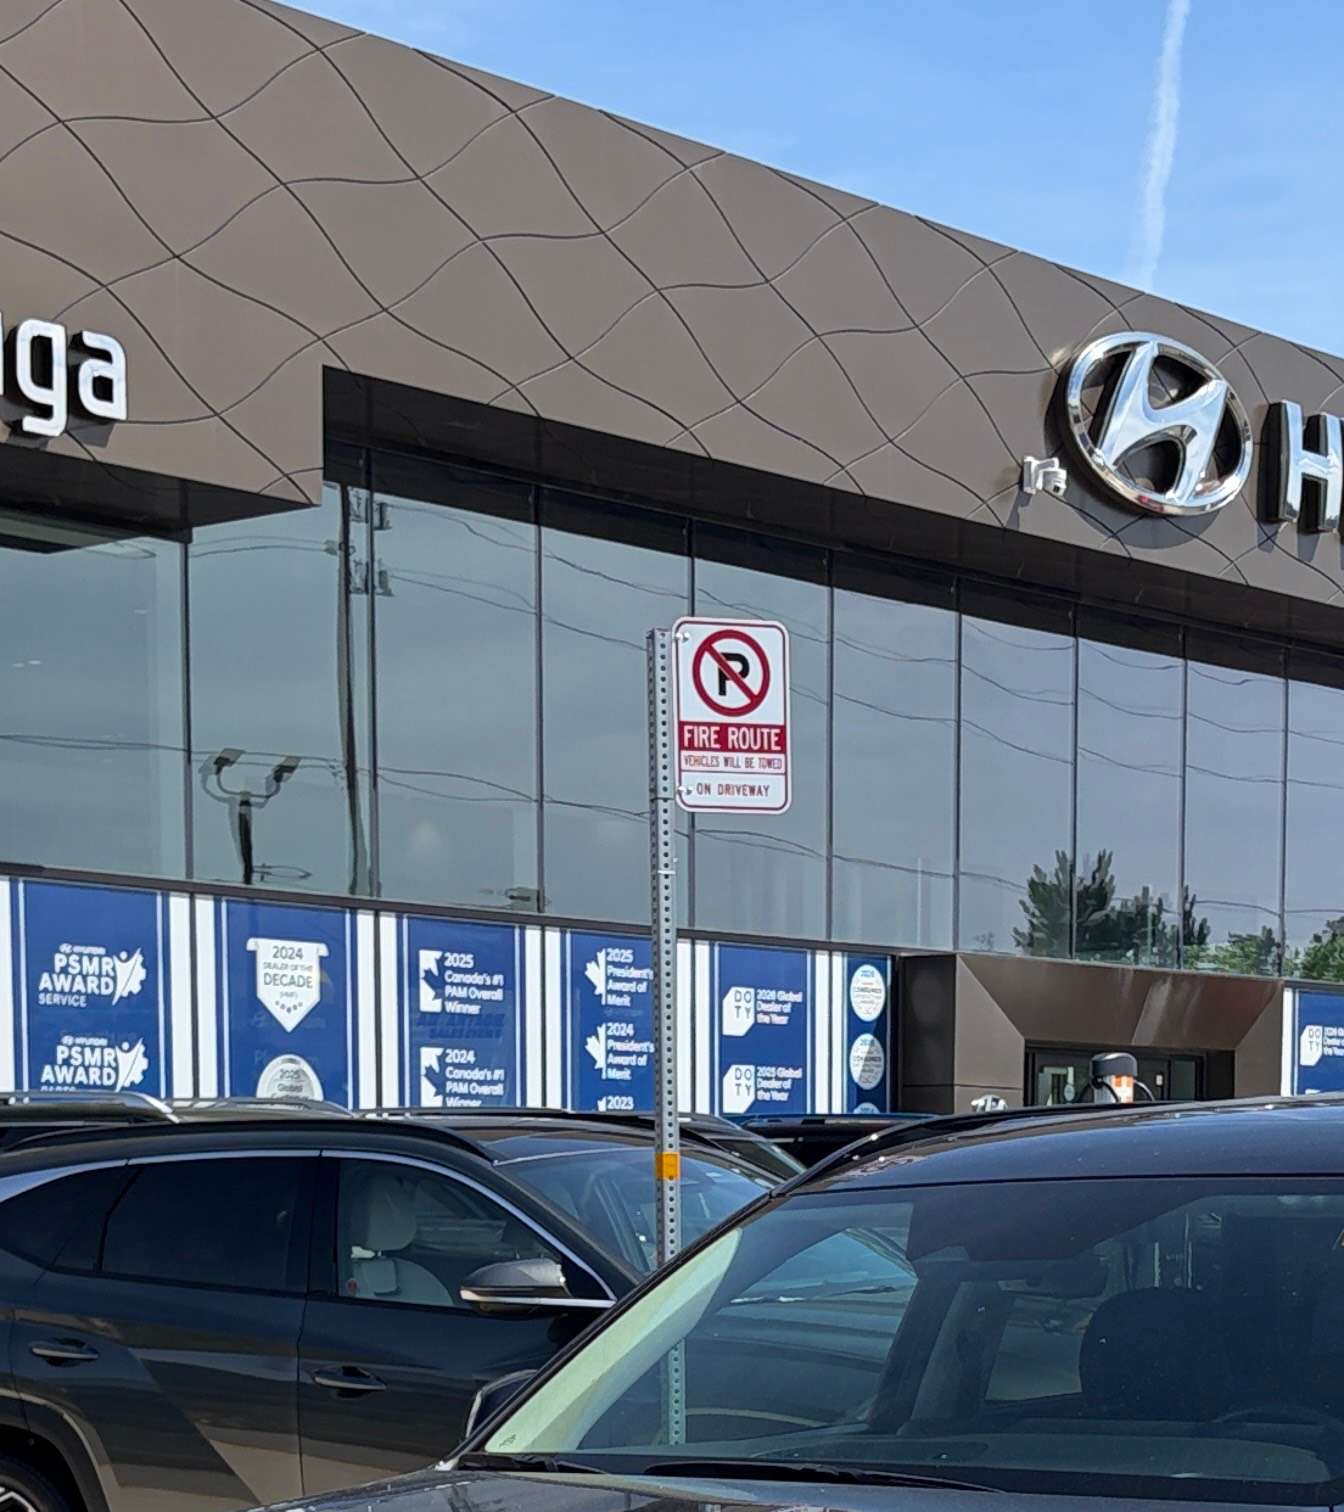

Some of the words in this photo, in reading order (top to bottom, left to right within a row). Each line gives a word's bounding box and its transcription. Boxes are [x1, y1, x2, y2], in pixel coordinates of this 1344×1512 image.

[683, 725, 721, 749] FIRE
[728, 727, 782, 751] ROUTE
[684, 755, 720, 768] VEHICLES
[723, 756, 741, 769] WILL
[745, 757, 755, 769] BE
[758, 757, 783, 770] TOWED
[696, 783, 711, 795] ON
[718, 783, 771, 797] DRIVEWAY
[272, 945, 304, 960] 2024
[444, 952, 474, 968] 2025
[607, 948, 634, 963] 2025
[54, 953, 115, 976] PSMR
[444, 970, 491, 985] Canada's
[492, 974, 504, 986] #1
[607, 965, 654, 980] President's
[39, 972, 114, 995] AWARD
[263, 972, 313, 989] DECADE
[607, 979, 636, 993] Award
[637, 981, 647, 993] of
[445, 985, 467, 998] PAM
[468, 987, 503, 1000] Overall
[38, 993, 88, 1008] SERVICE
[444, 1000, 481, 1014] Winner
[607, 994, 631, 1007] Merit
[756, 1000, 782, 1013] Dealer
[607, 1022, 635, 1036] 2024
[607, 1039, 655, 1053] President's
[56, 1045, 117, 1068] PSMR
[445, 1048, 476, 1064] 2024
[607, 1053, 636, 1066] Award
[637, 1054, 648, 1066] of
[40, 1064, 117, 1086] AWARD
[445, 1066, 492, 1081] Canada's
[493, 1069, 505, 1081] #1
[607, 1067, 632, 1080] Merit
[446, 1081, 469, 1093] PAM
[469, 1082, 504, 1096] Overall
[756, 1078, 782, 1089] Dealer
[607, 1095, 635, 1110] 2023
